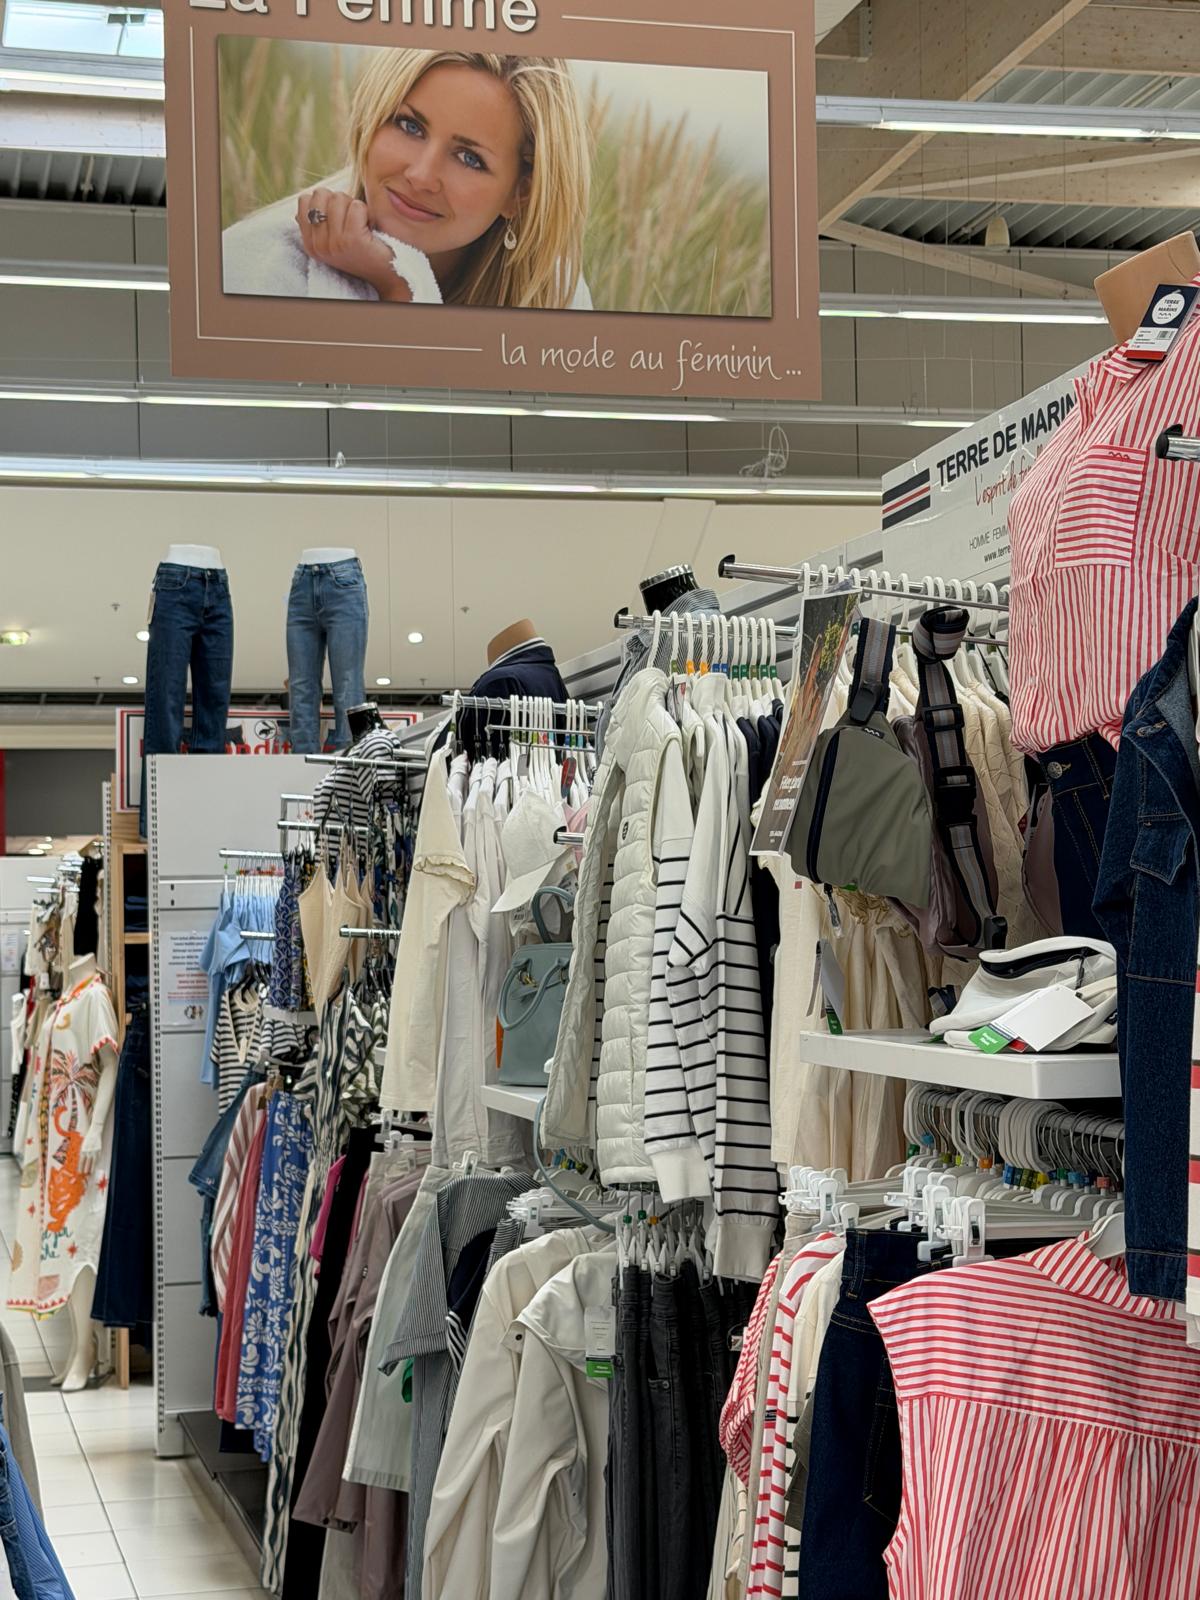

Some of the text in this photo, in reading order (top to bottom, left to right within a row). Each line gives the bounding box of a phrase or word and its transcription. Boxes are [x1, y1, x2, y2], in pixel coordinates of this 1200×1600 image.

[501, 333, 527, 365] la
[541, 336, 616, 373] mode
[630, 350, 664, 370] au
[936, 437, 990, 486] TERRE
[993, 423, 1017, 459] DE
[1021, 390, 1078, 445] MARIN
[969, 531, 990, 550] HOMME
